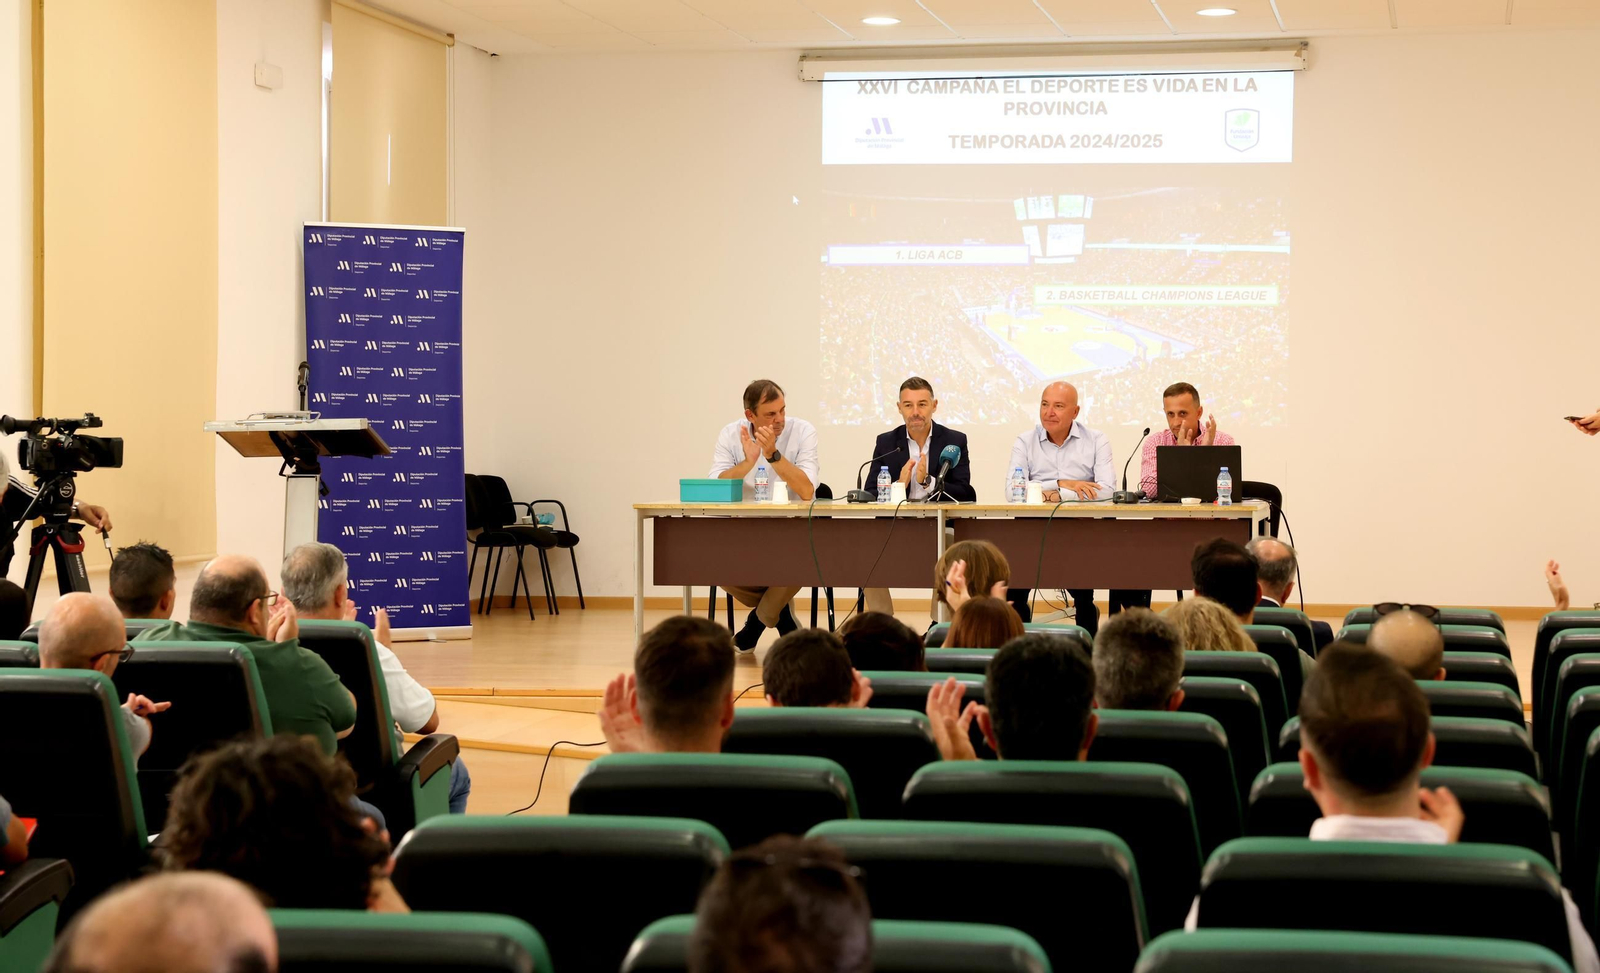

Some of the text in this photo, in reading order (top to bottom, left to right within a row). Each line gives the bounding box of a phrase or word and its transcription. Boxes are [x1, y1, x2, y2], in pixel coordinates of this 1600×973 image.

[857, 80, 898, 94] XXVI
[1003, 79, 1026, 94] EL
[1030, 79, 1120, 94] DEPORTE
[1124, 78, 1148, 93] ES
[1153, 78, 1199, 93] VIDA
[1203, 78, 1228, 93] EN
[1233, 77, 1258, 92] LA
[1004, 101, 1107, 116] PROVINCIA
[948, 134, 1163, 149] TEMPORADA 2024/2025
[895, 250, 963, 260] 1. LIGA ACB
[1046, 290, 1267, 301] 2. BASKETBALL CHAMPIONS LEAGUE
